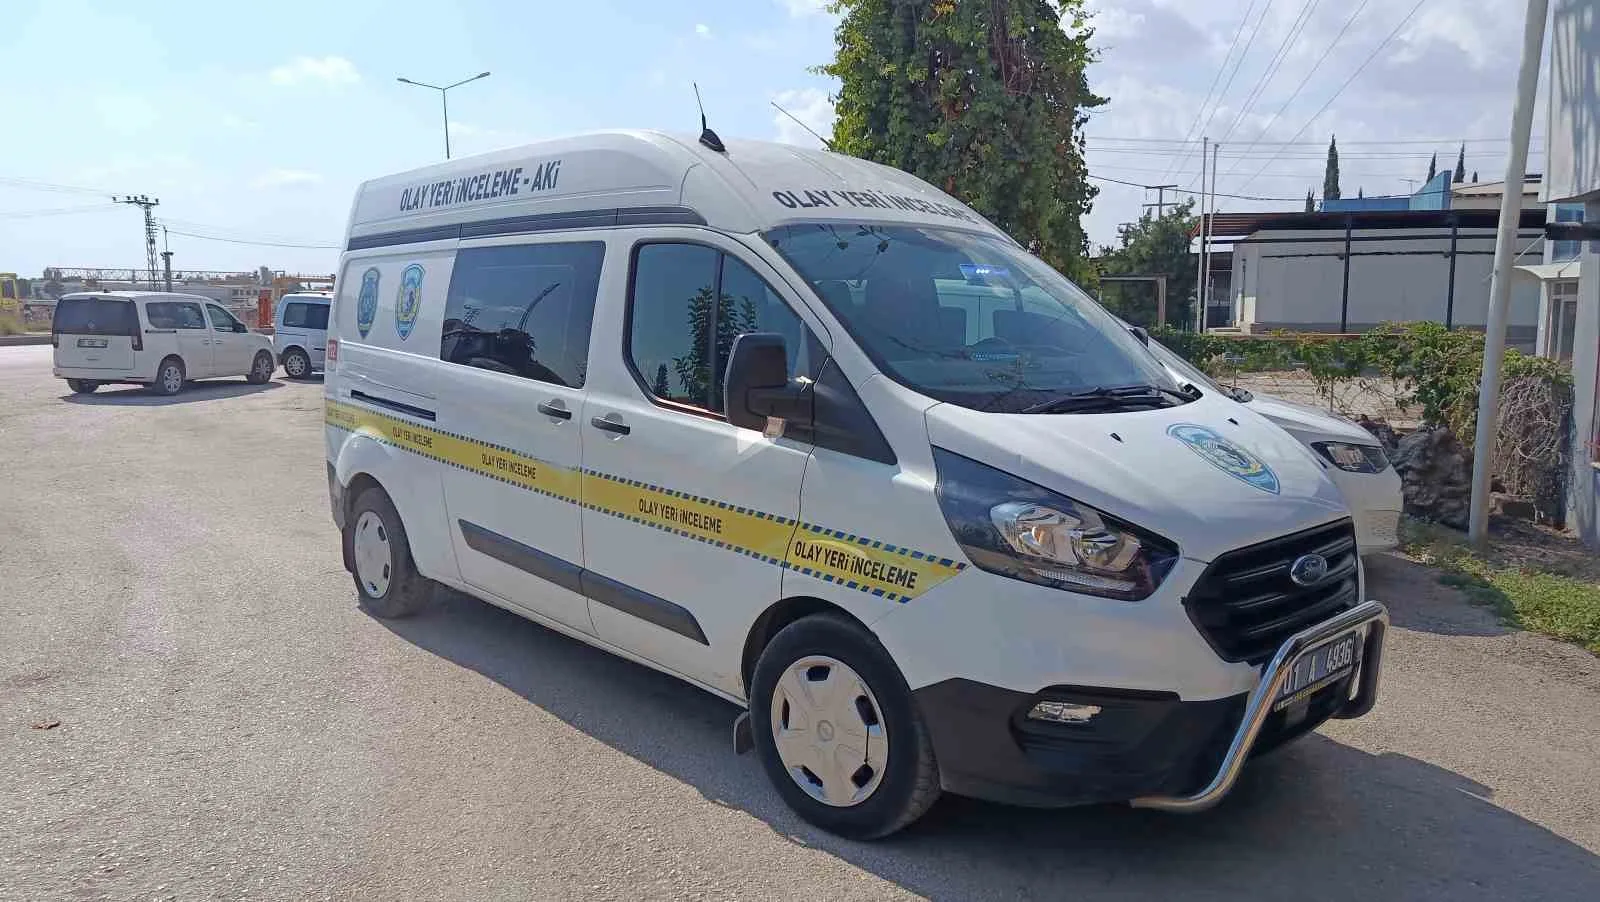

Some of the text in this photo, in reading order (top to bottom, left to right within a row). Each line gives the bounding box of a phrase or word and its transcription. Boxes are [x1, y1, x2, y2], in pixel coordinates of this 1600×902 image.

[400, 185, 429, 211] OLAY
[772, 190, 838, 208] OLAY
[639, 498, 659, 516] OLAY
[795, 541, 822, 563] OLAY
[1308, 655, 1316, 682] A
